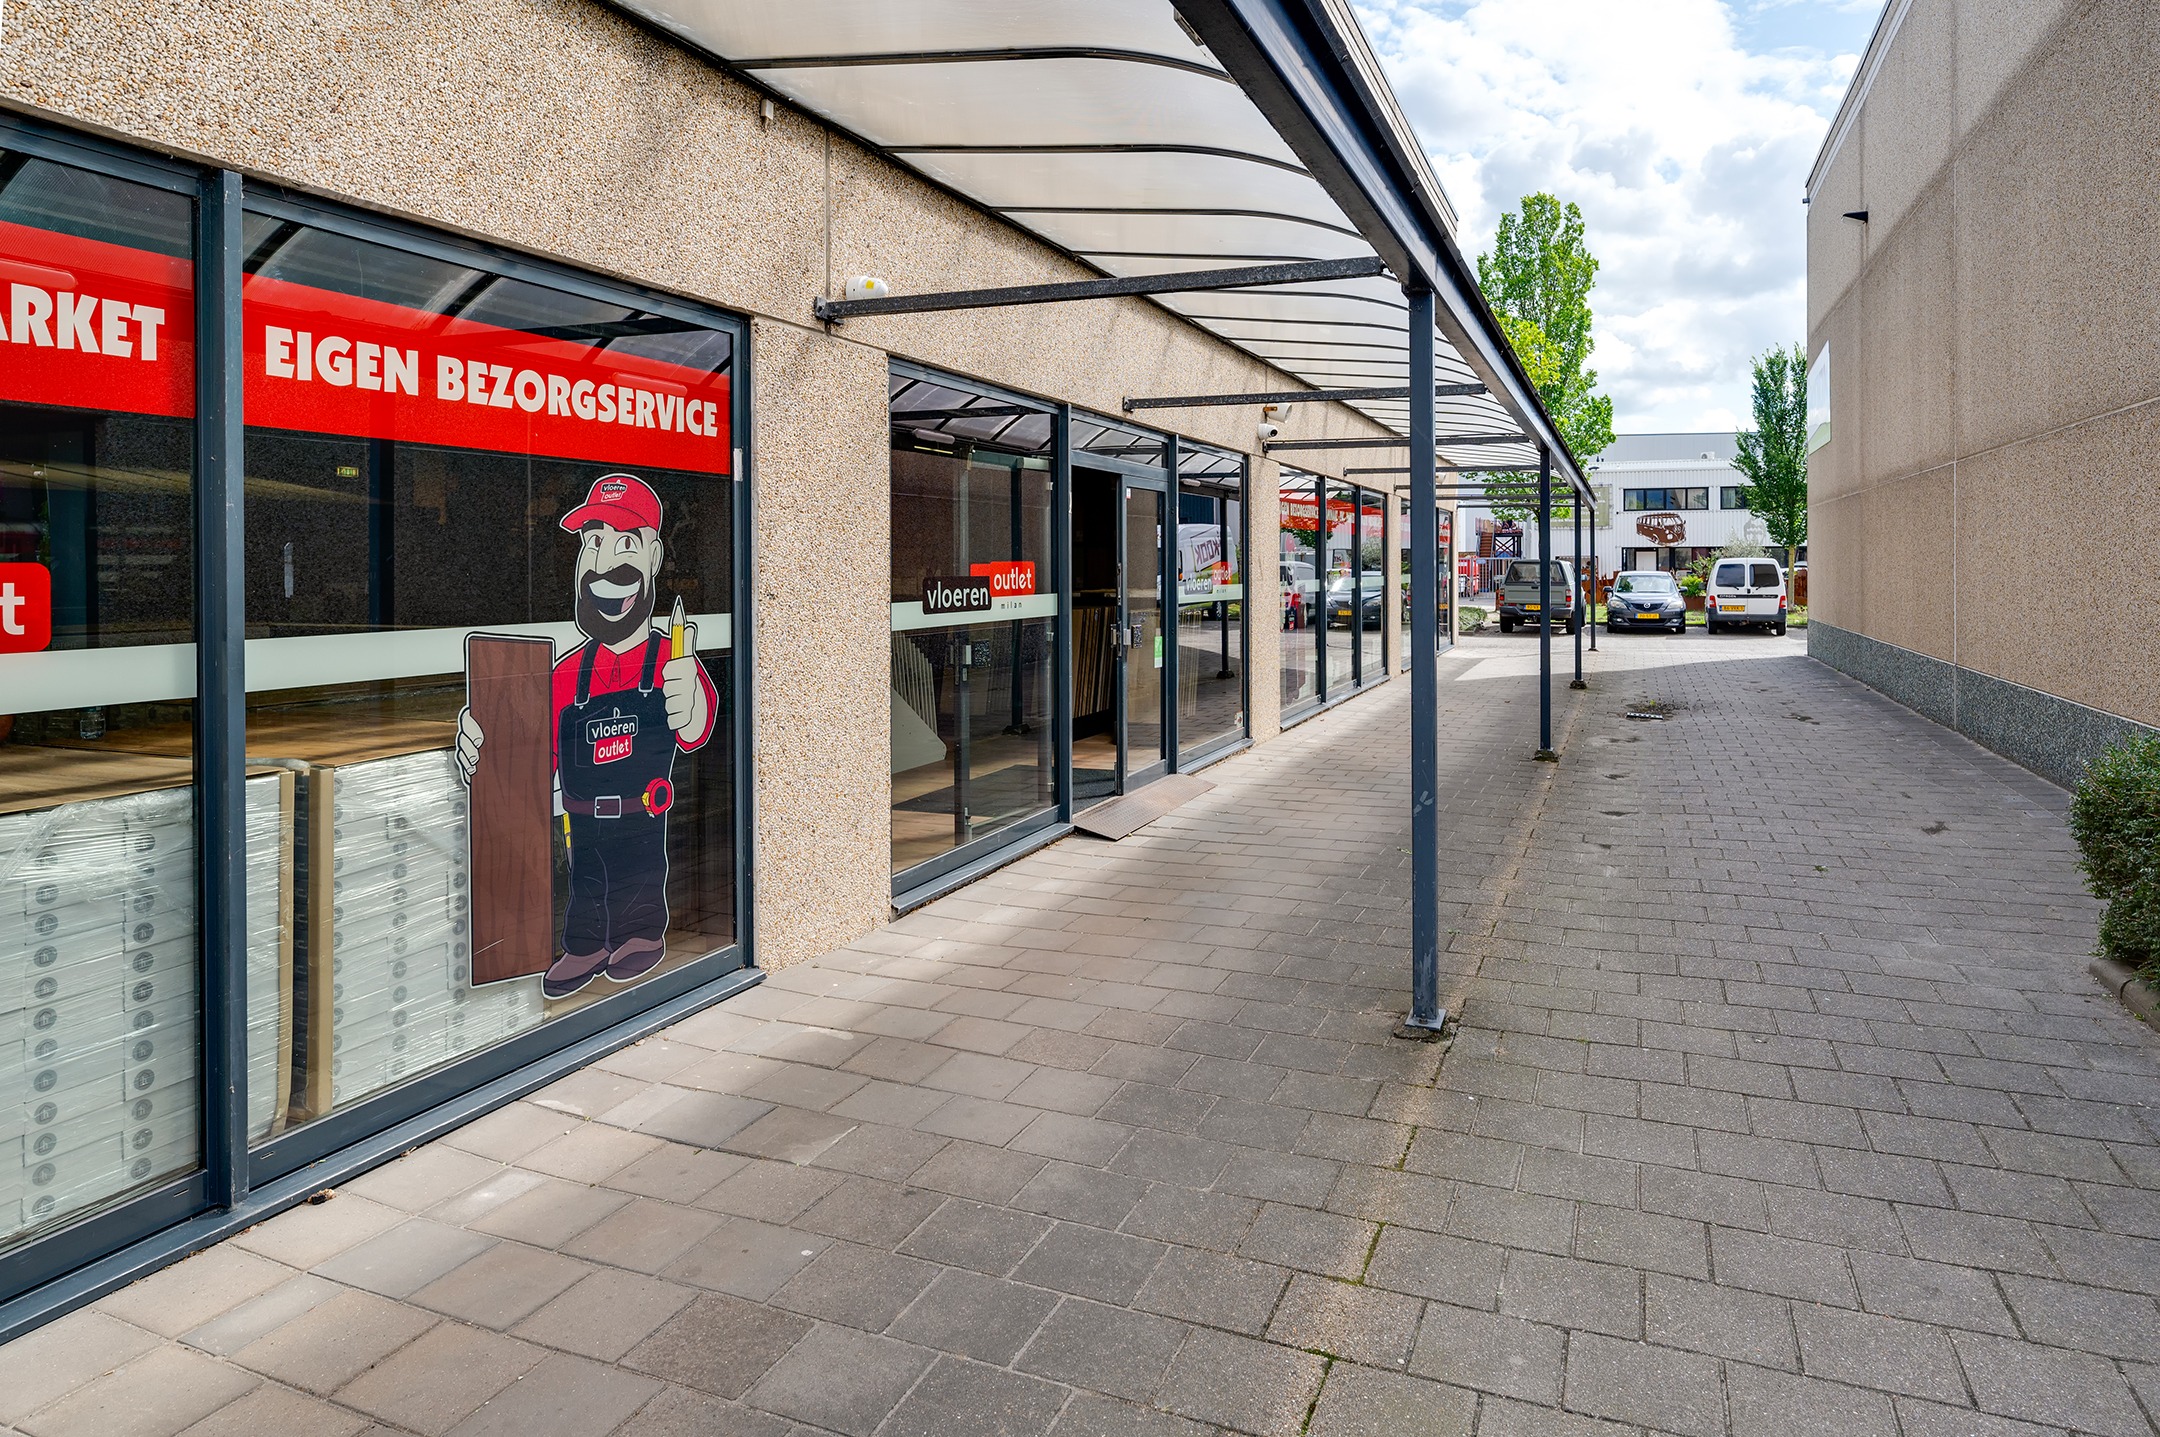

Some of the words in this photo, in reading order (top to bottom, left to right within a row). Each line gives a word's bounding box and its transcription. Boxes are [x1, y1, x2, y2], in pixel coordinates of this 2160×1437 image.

[0, 282, 165, 361] RKET
[265, 325, 419, 396] EIGEN
[437, 355, 718, 437] BEZORGSERVICE
[994, 567, 1032, 590] outlet
[1186, 573, 1212, 591] vloeren
[1214, 566, 1231, 581] outlet
[927, 581, 989, 609] vloeren
[591, 722, 635, 738] vloeren
[598, 739, 629, 759] outlet
